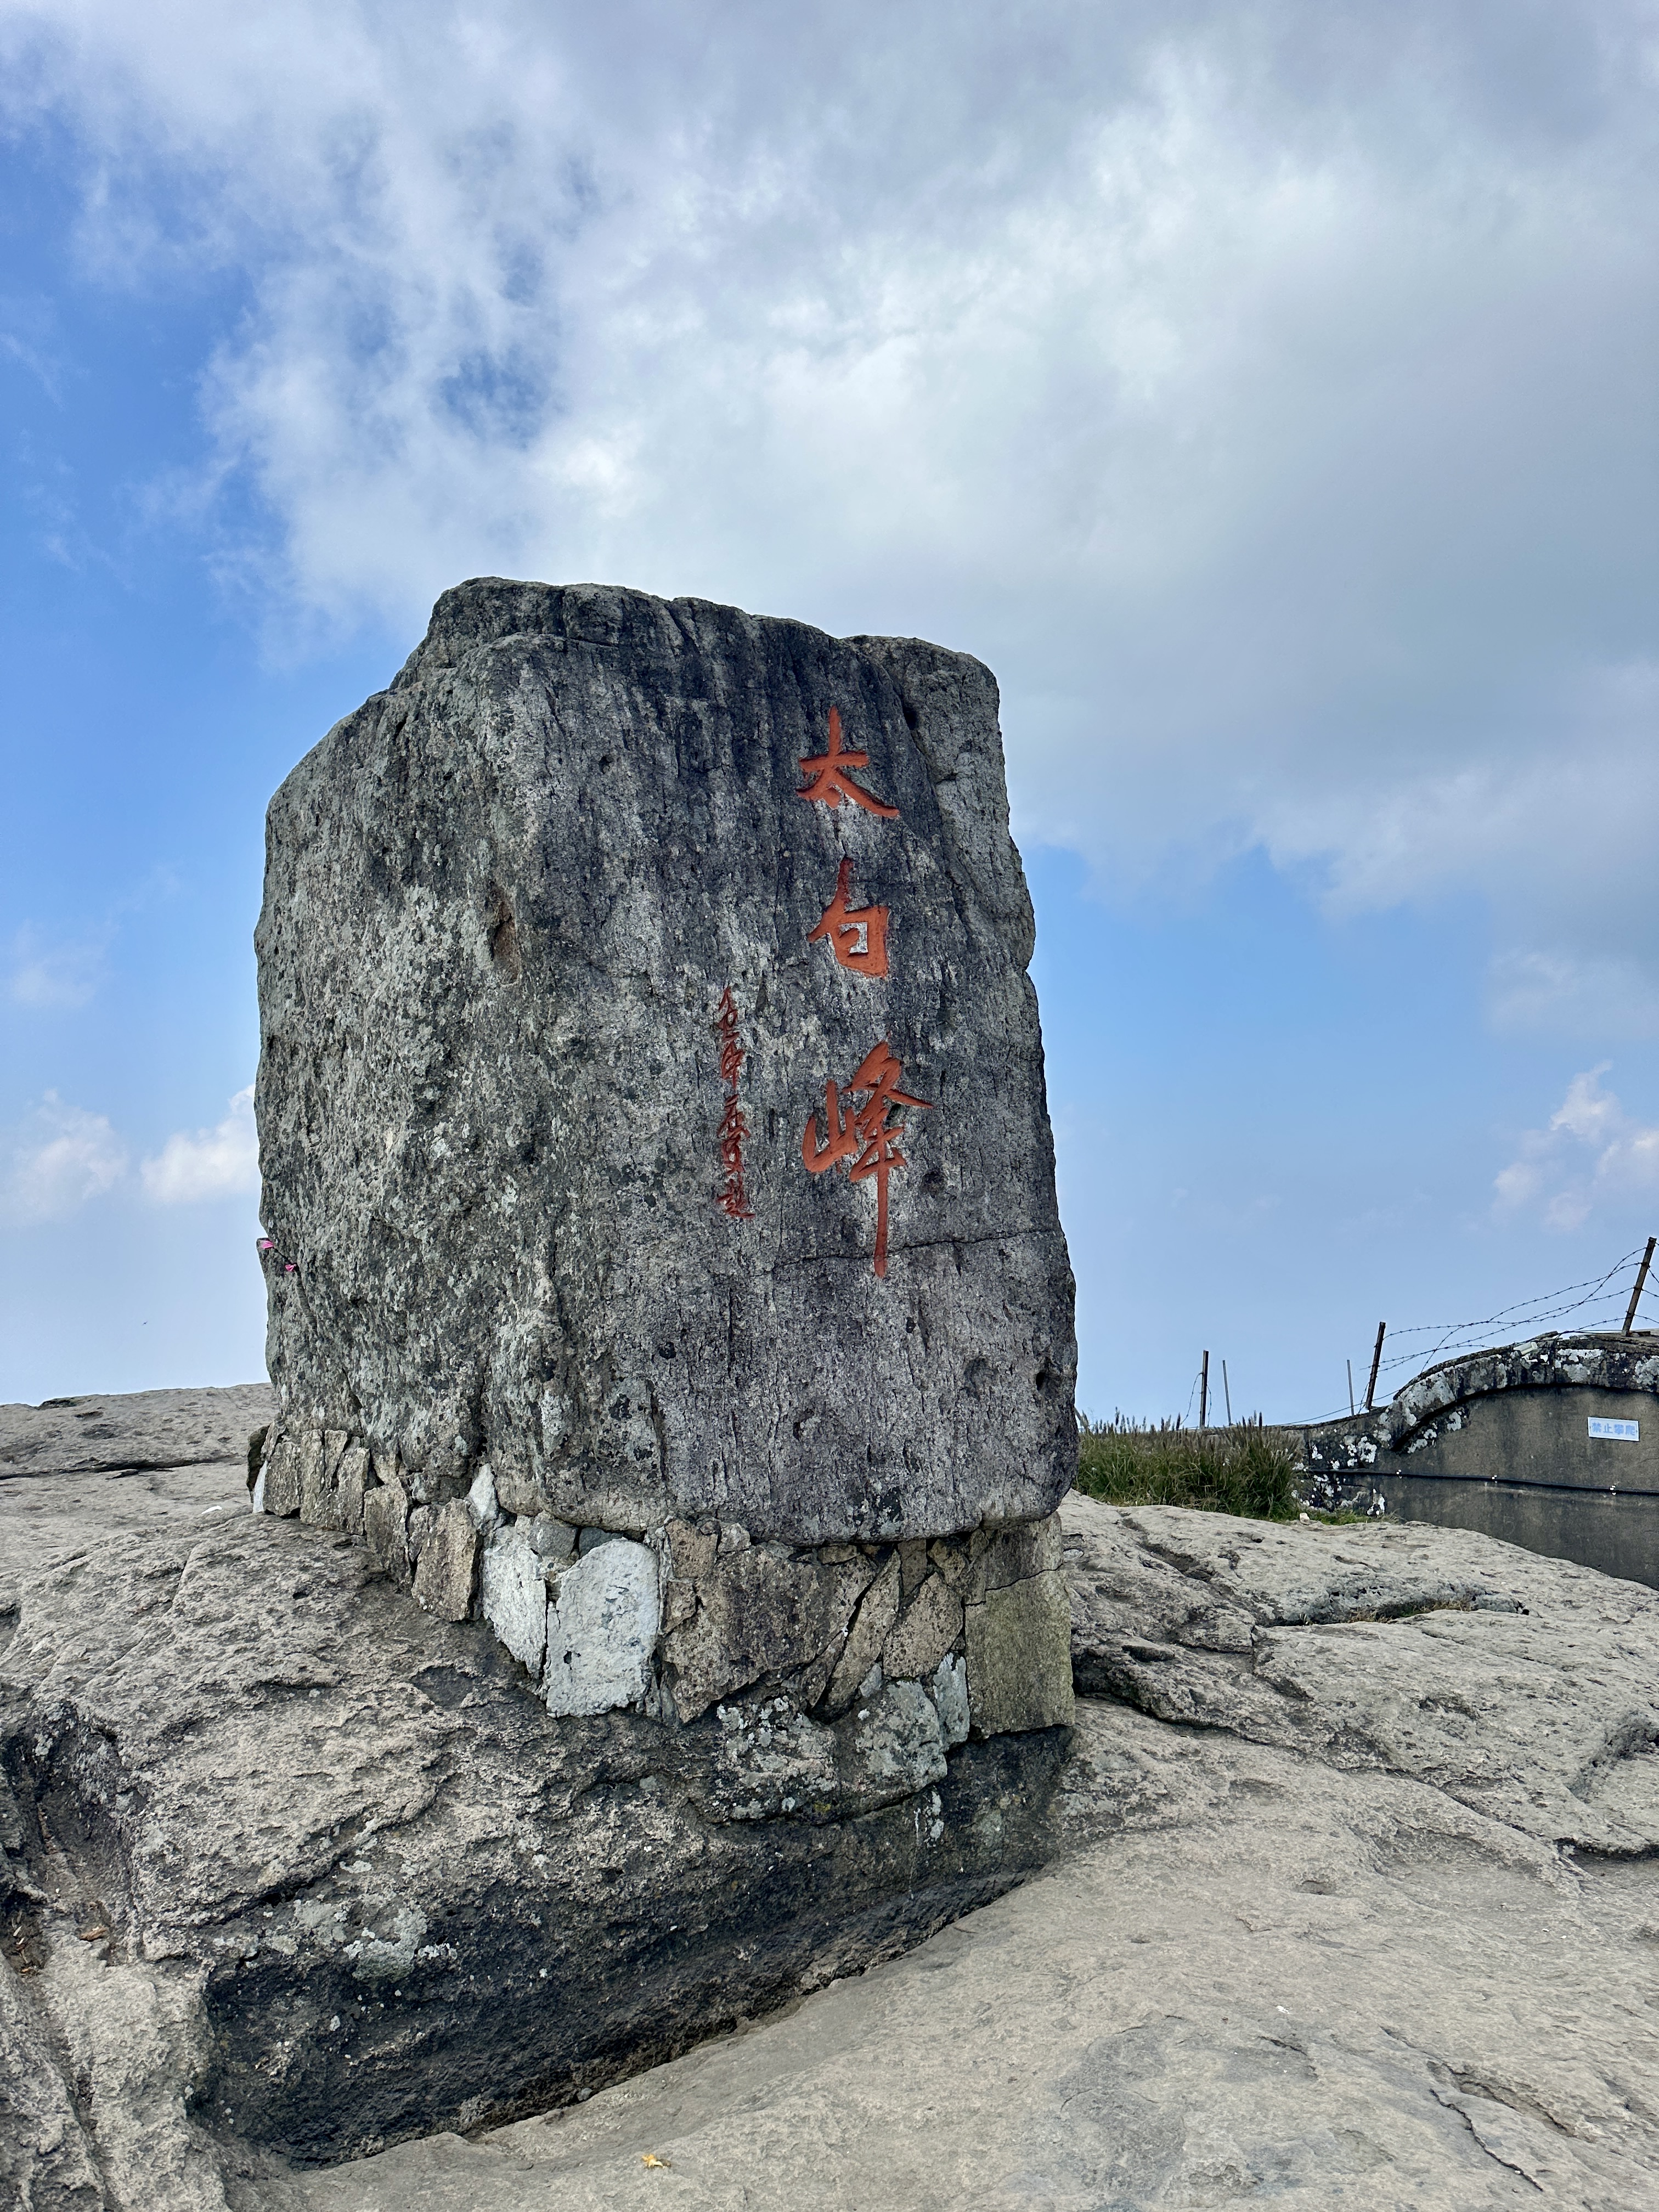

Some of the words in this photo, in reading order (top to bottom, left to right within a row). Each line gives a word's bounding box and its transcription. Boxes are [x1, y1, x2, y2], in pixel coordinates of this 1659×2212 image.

[797, 705, 934, 1277] 太白峰
[1592, 1421, 1635, 1436] 禁止攀爬
